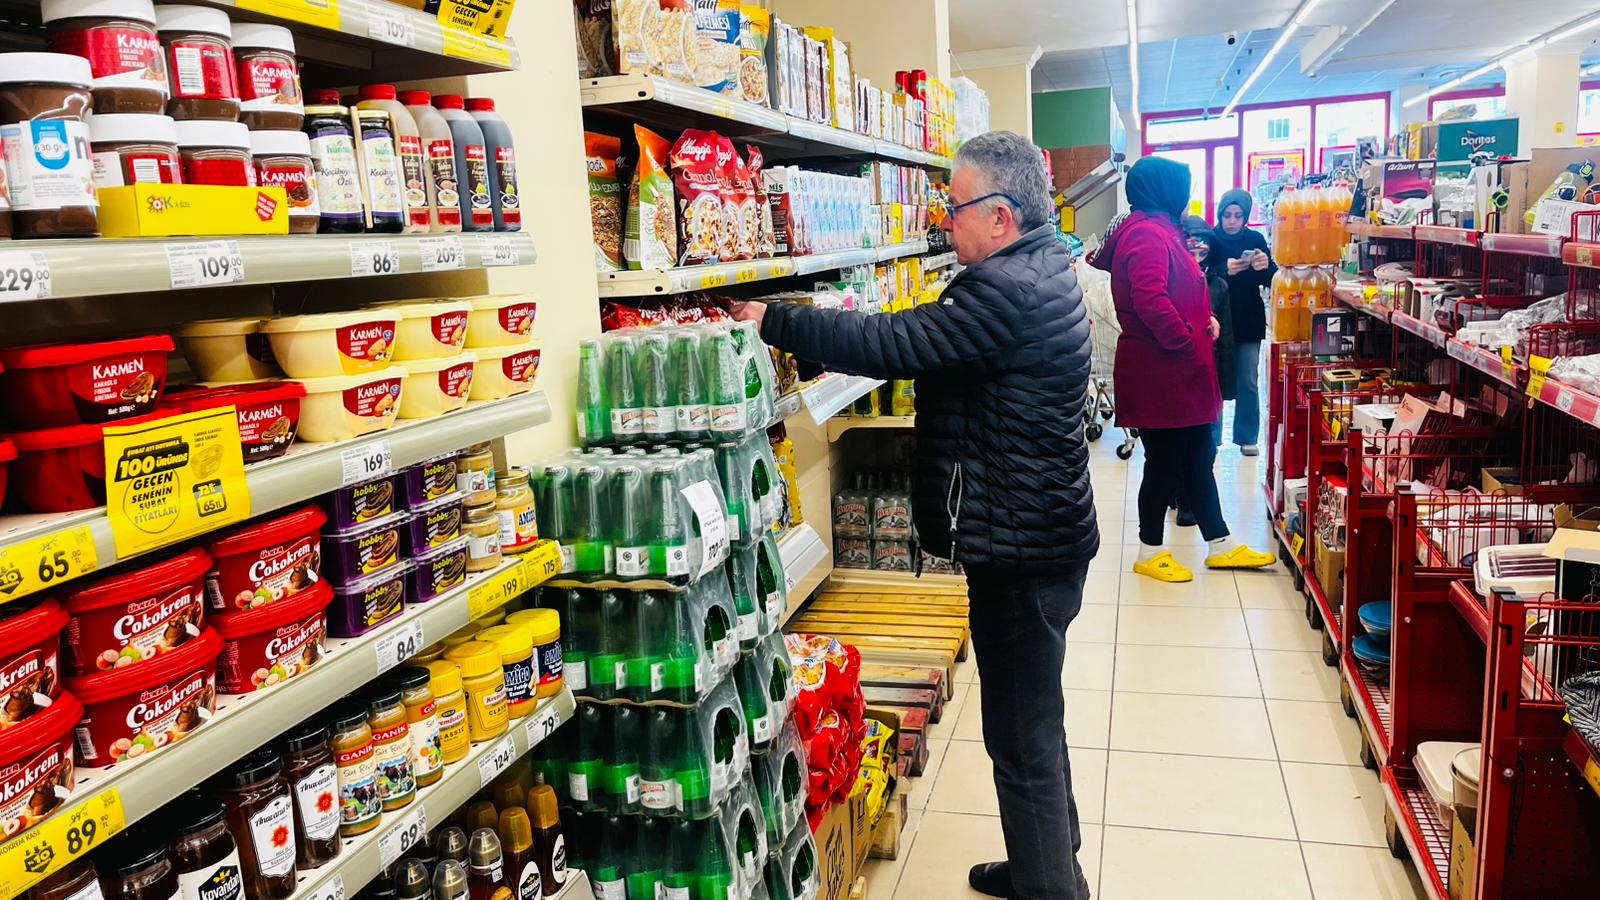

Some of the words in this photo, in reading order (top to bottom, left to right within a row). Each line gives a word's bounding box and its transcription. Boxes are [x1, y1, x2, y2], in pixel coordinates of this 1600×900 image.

[455, 6, 478, 19] GEÇEN
[251, 65, 294, 79] KARMEN
[1461, 136, 1496, 146] Doritos
[261, 170, 308, 183] KARMEN
[373, 253, 391, 273] 86
[436, 248, 456, 264] 209
[350, 326, 382, 341] KARMEN
[93, 357, 144, 380] KARMEN
[358, 382, 389, 399] KARMEN
[239, 404, 282, 423] KARMEN
[119, 455, 156, 479] 100
[156, 452, 188, 468] ÜRÜNDE
[363, 453, 383, 473] 169
[133, 471, 173, 492] GEÇEN
[353, 484, 379, 498] hobby
[131, 486, 173, 504] SENENİN
[203, 499, 216, 512] 65
[359, 534, 384, 549] hobby
[39, 551, 69, 582] 65
[249, 543, 311, 587] Çokokrem
[543, 560, 555, 575] 175
[502, 578, 518, 597] 199
[113, 594, 191, 646] Çokokrem
[265, 619, 321, 665] Çokokrem
[397, 635, 416, 662] 84
[126, 677, 203, 733] Çokokrem
[372, 724, 407, 741] GANİK
[440, 726, 465, 740] LASSIC
[542, 716, 555, 737] 79
[340, 743, 374, 762] GANİK
[494, 750, 509, 771] 124
[0, 751, 59, 802] kokrem
[67, 819, 96, 854] 89
[401, 824, 417, 851] 89
